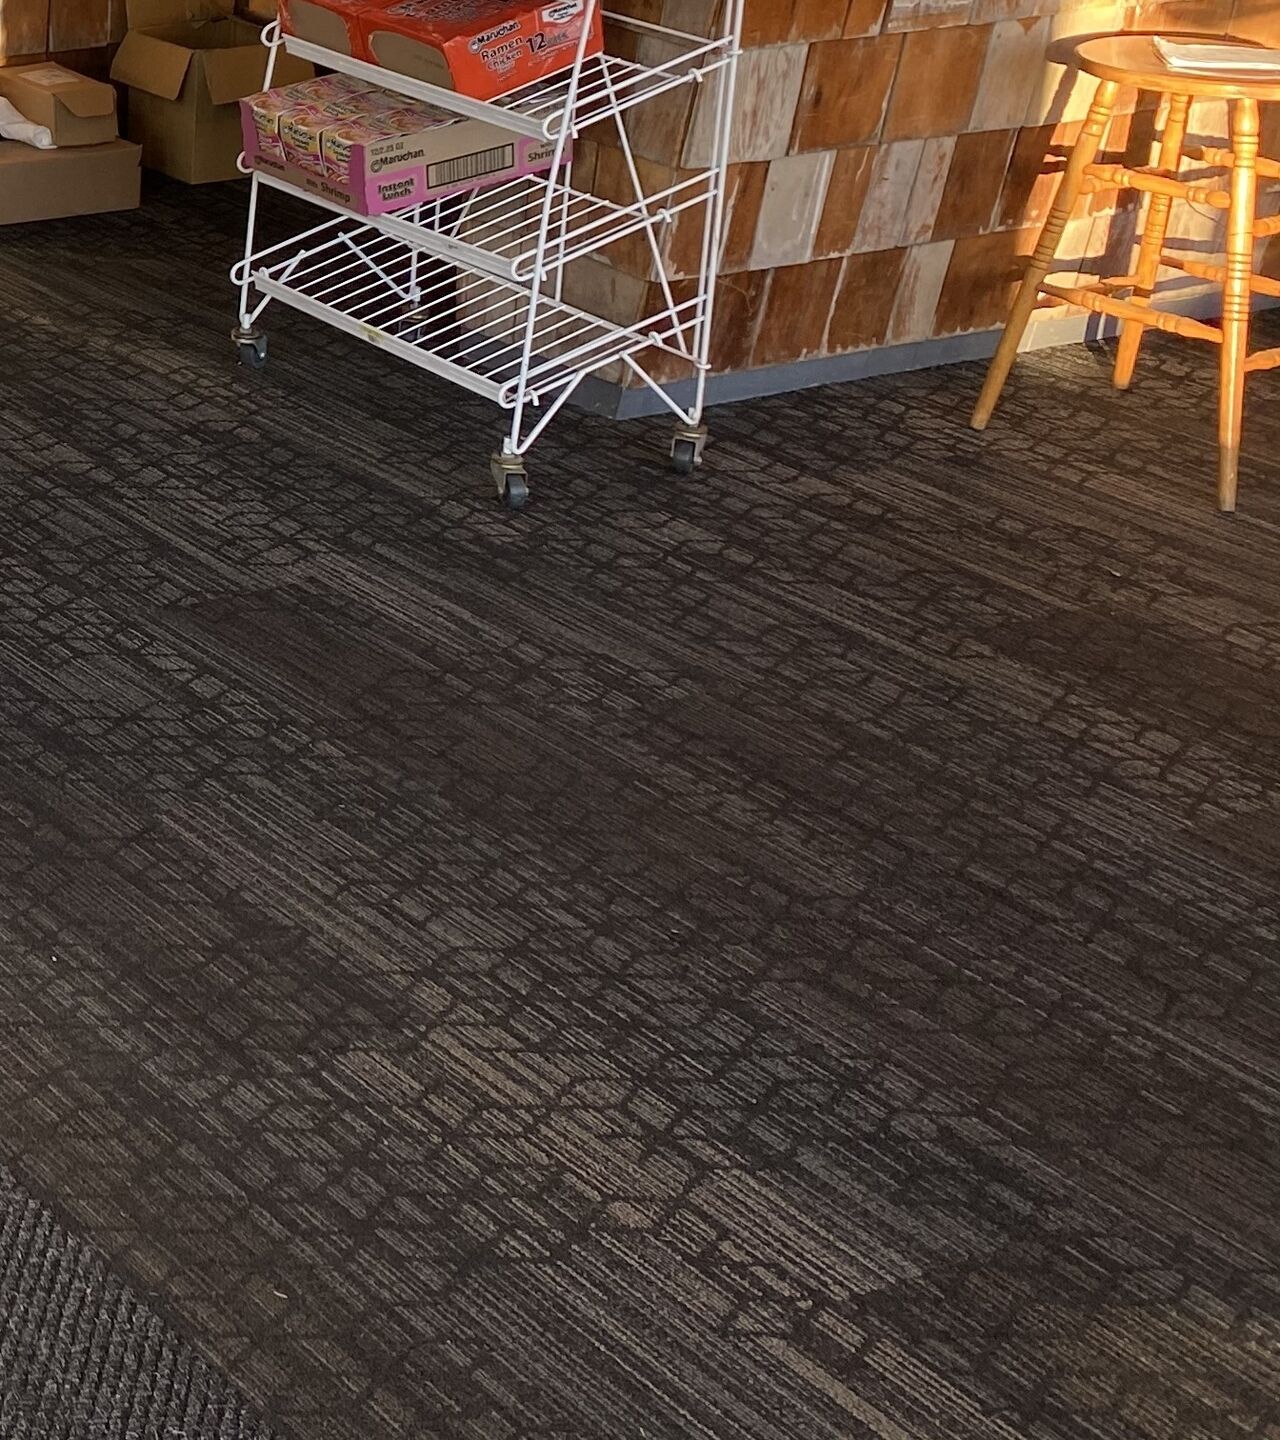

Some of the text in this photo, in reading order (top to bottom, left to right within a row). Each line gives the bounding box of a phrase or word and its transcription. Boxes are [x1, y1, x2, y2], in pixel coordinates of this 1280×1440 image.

[476, 21, 520, 47] Maruchan
[525, 32, 548, 54] 12
[481, 35, 523, 61] Ramen
[380, 149, 424, 166] Maruchan
[528, 148, 565, 162] Shrim
[377, 178, 414, 194] Instant
